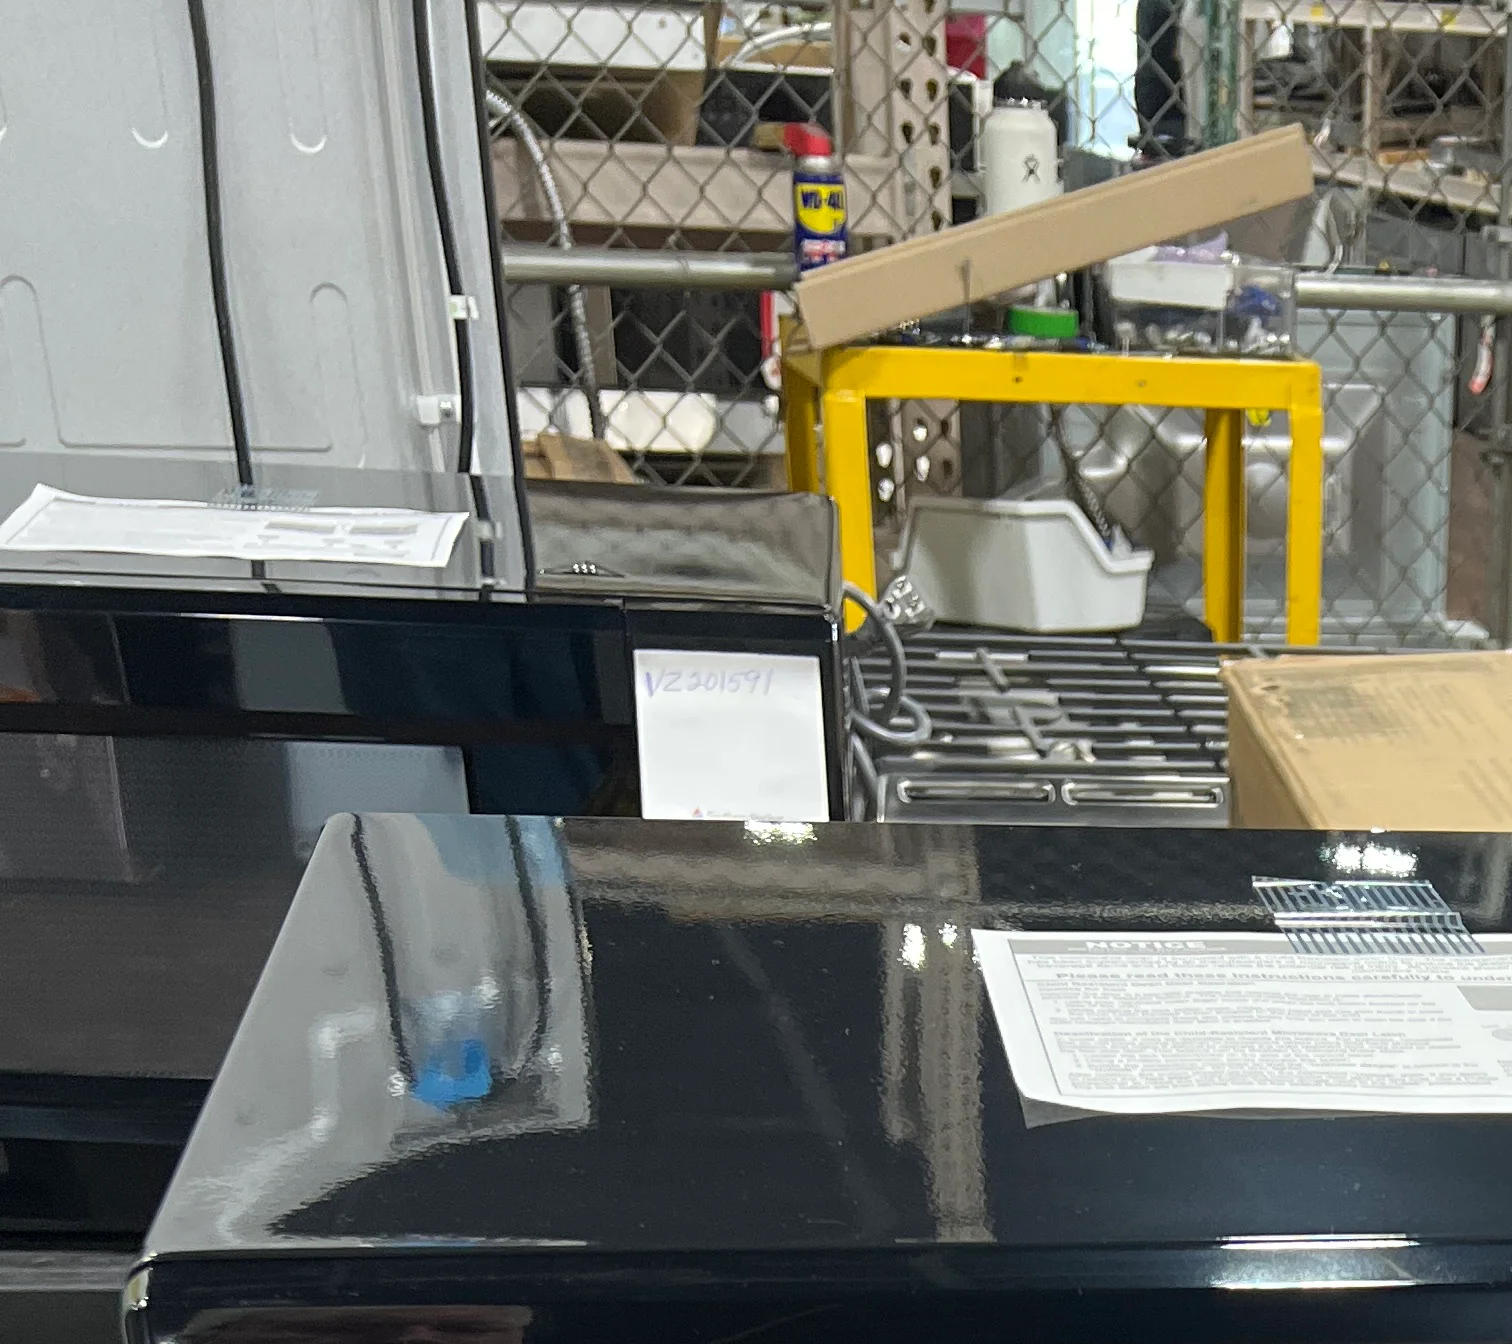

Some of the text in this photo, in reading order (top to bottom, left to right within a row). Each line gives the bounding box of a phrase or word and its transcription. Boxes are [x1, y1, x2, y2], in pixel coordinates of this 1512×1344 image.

[1085, 940, 1207, 949] NOTICE
[1232, 972, 1346, 981] instructions
[1351, 973, 1431, 982] carefully
